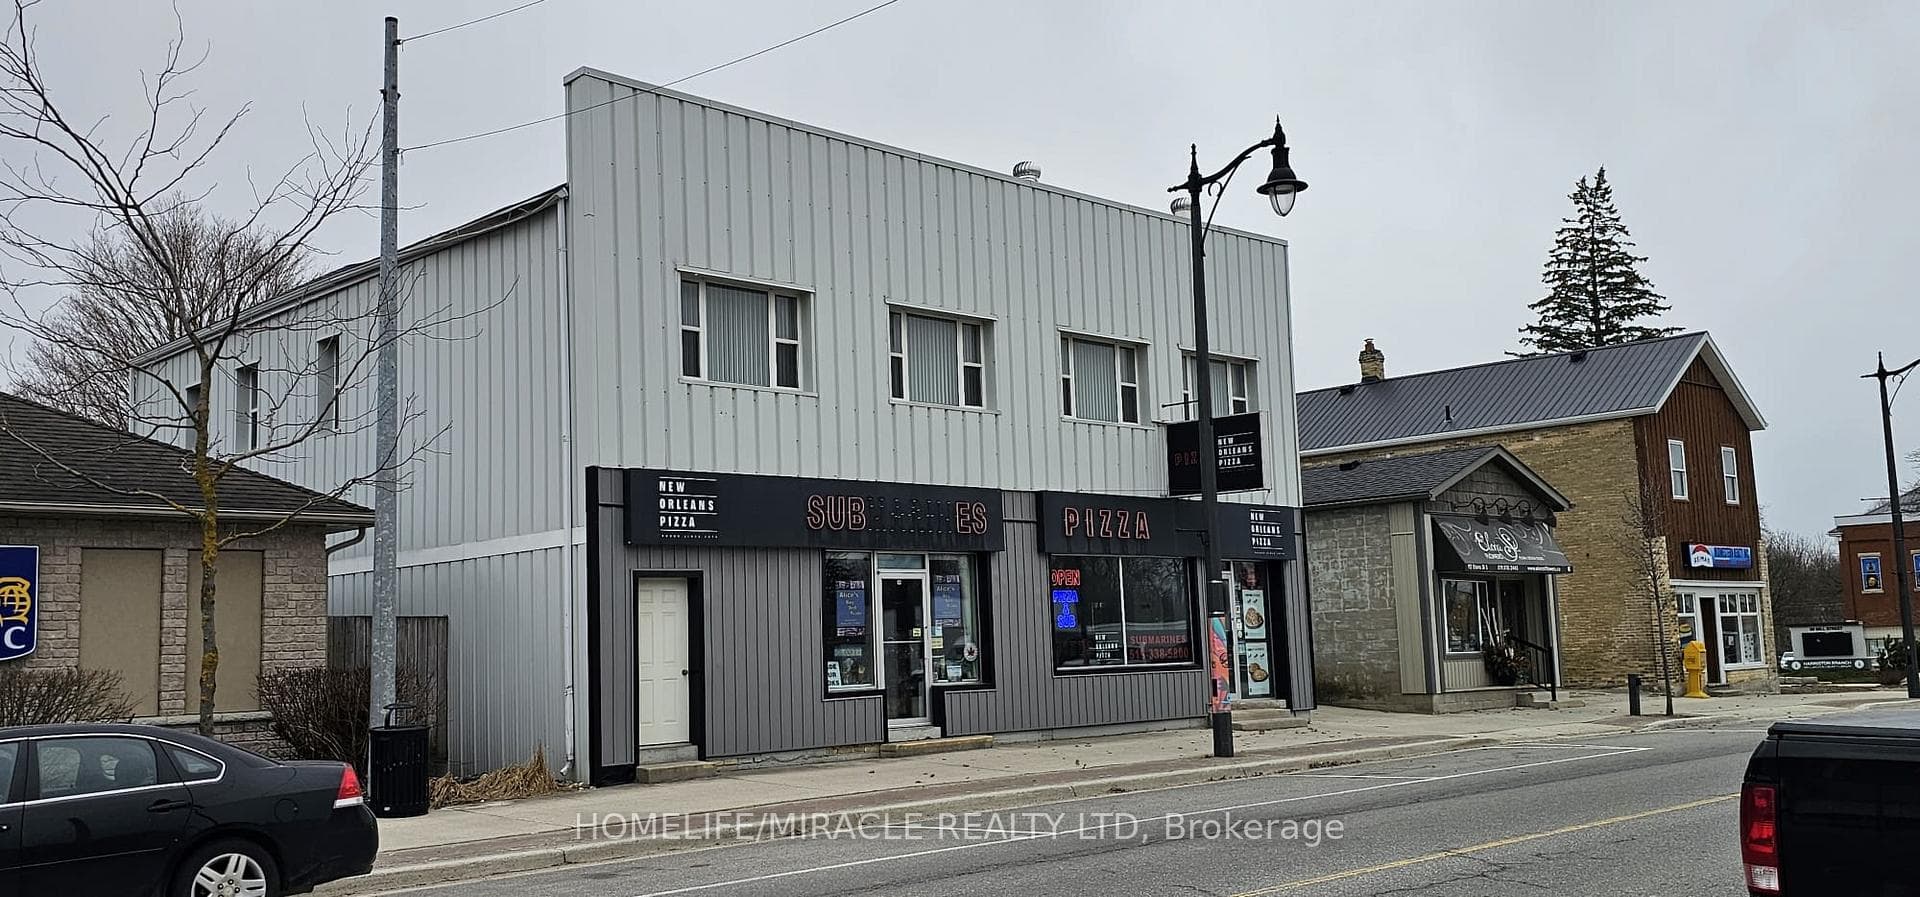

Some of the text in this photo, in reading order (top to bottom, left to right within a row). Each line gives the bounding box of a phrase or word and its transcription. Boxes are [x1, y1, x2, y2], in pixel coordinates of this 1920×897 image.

[1218, 437, 1234, 445] NEW
[1218, 445, 1253, 456] ORLEANS
[1218, 457, 1241, 467] PIZZA
[659, 480, 685, 493] NEW
[659, 498, 714, 511] ORLEANS
[659, 515, 696, 528] PIZZA
[1250, 512, 1264, 521] NEW
[1064, 507, 1150, 539] PIZZA
[1251, 524, 1281, 535] ORLEANS
[1251, 537, 1272, 546] PIZZA
[1051, 569, 1081, 586] OPEN
[1053, 589, 1078, 603] PIZZA
[1057, 614, 1076, 629] SUB
[1130, 634, 1187, 645] SUBMARINES
